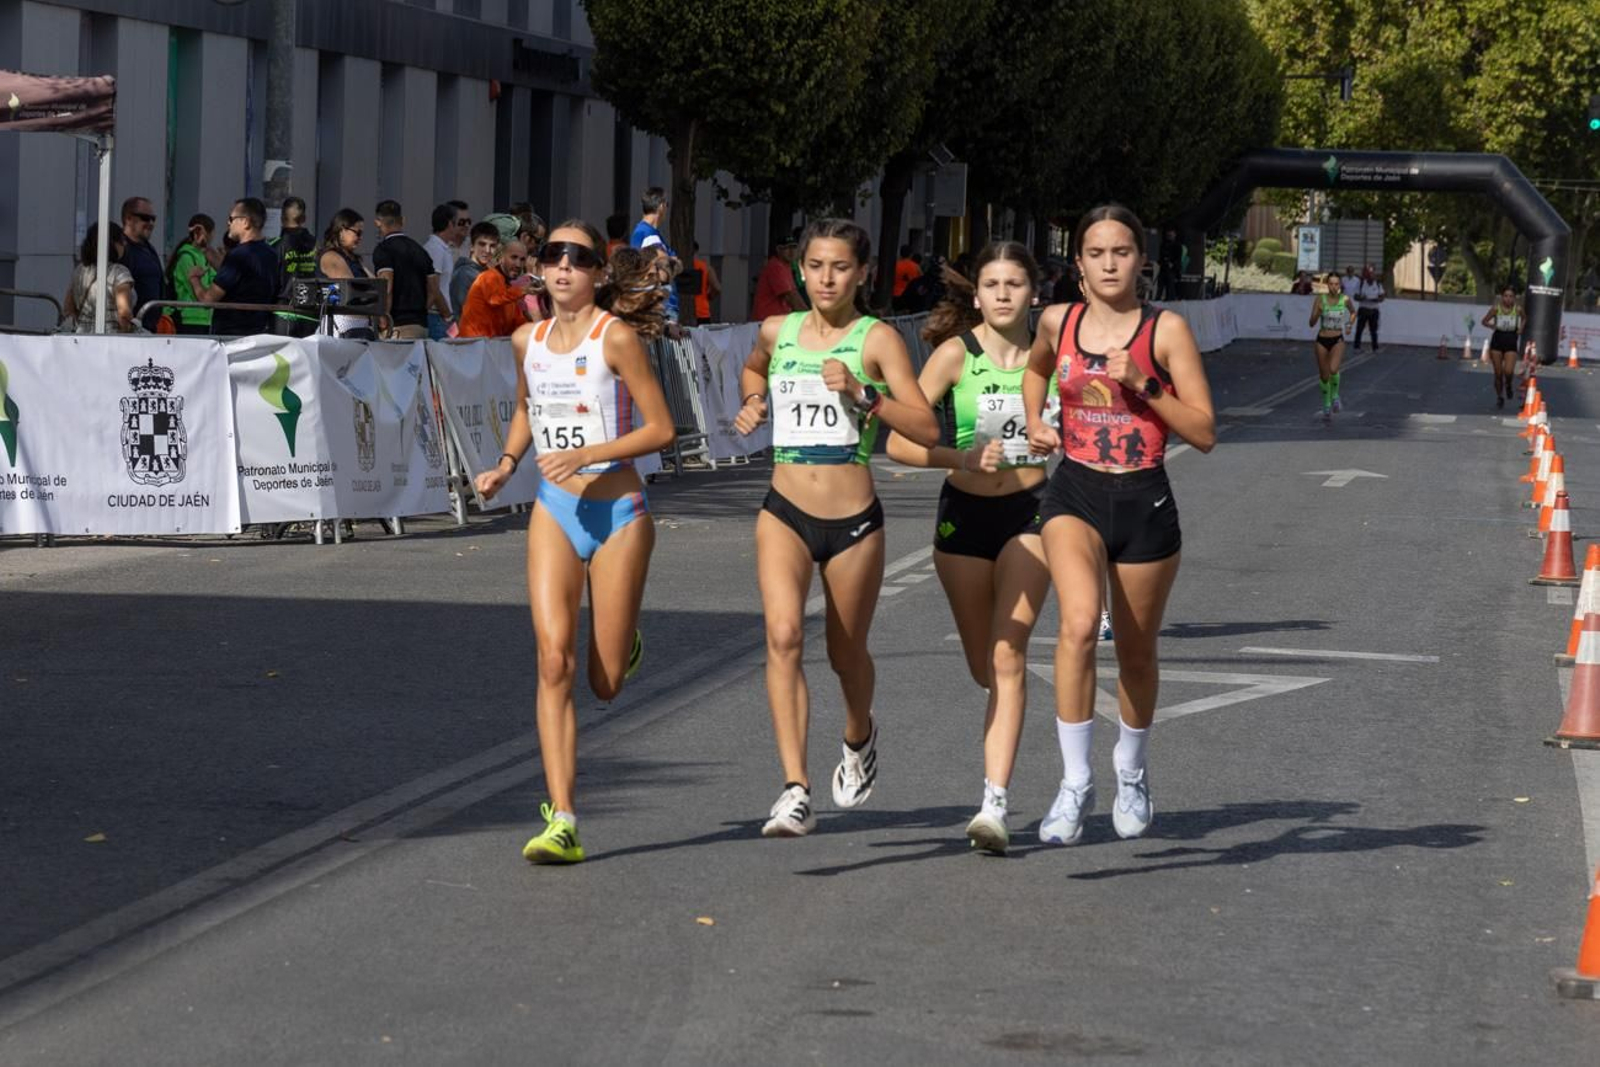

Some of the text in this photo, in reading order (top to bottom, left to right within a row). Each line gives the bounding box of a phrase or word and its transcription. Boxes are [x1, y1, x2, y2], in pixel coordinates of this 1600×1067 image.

[779, 381, 795, 394] 37
[987, 399, 1004, 411] 37
[791, 404, 838, 427] 170
[542, 426, 585, 449] 155
[237, 464, 286, 477] Patronato
[288, 461, 330, 475] Municipal
[53, 474, 67, 487] de
[253, 474, 334, 492] Deportes de Jaén
[20, 487, 35, 500] de
[107, 490, 210, 508] CIUDAD DE JAÉN
